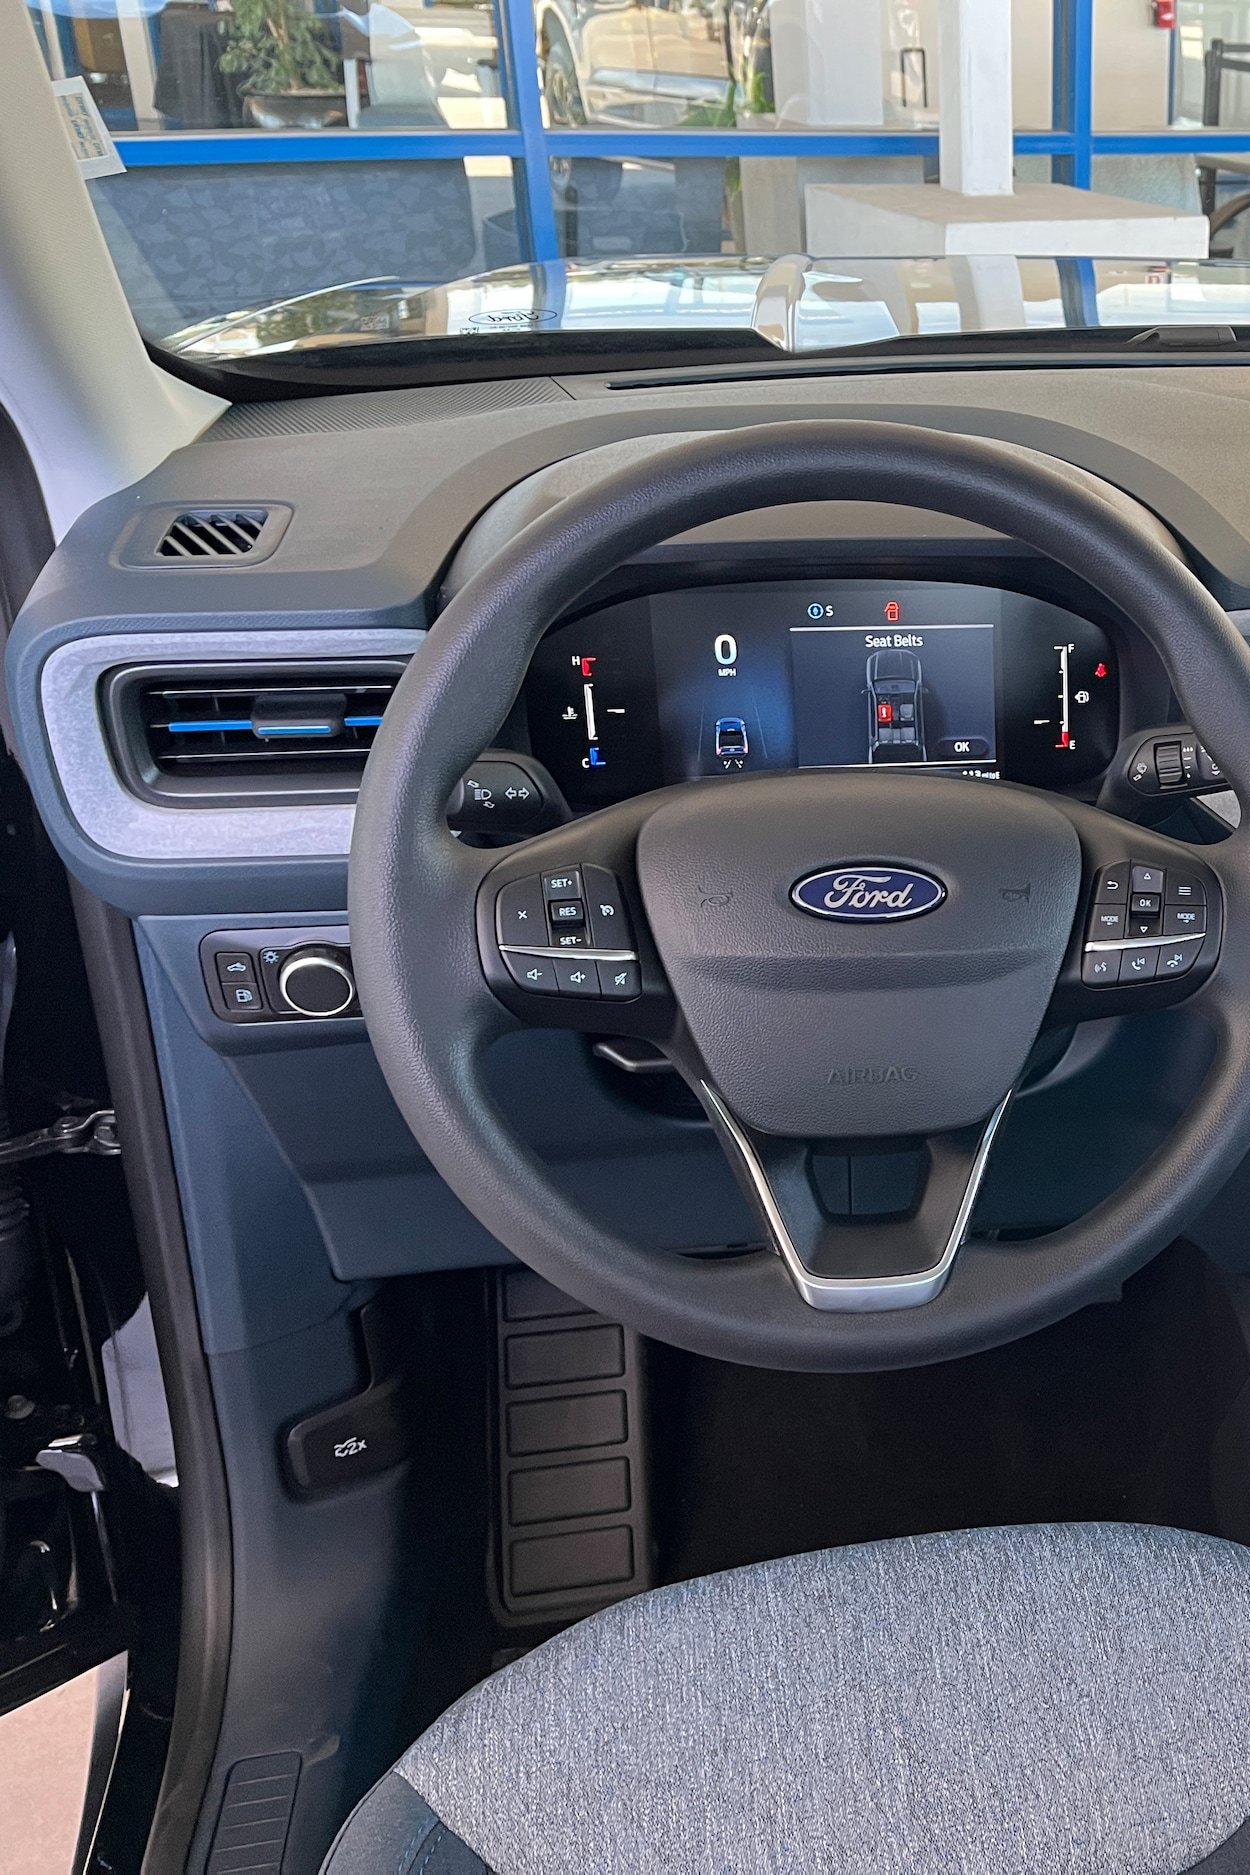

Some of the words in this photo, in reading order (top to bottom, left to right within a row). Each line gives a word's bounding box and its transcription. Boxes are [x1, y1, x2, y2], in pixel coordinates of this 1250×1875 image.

[865, 635, 892, 648] Seat
[895, 634, 923, 647] Belts
[714, 634, 738, 665] 0
[718, 667, 737, 678] MPH
[953, 741, 971, 753] OK
[823, 874, 913, 909] Ford
[1139, 899, 1151, 908] OK
[559, 907, 577, 917] RES
[1177, 913, 1196, 921] MODE
[1101, 915, 1119, 923] MODE
[826, 1066, 920, 1085] AIRBAG
